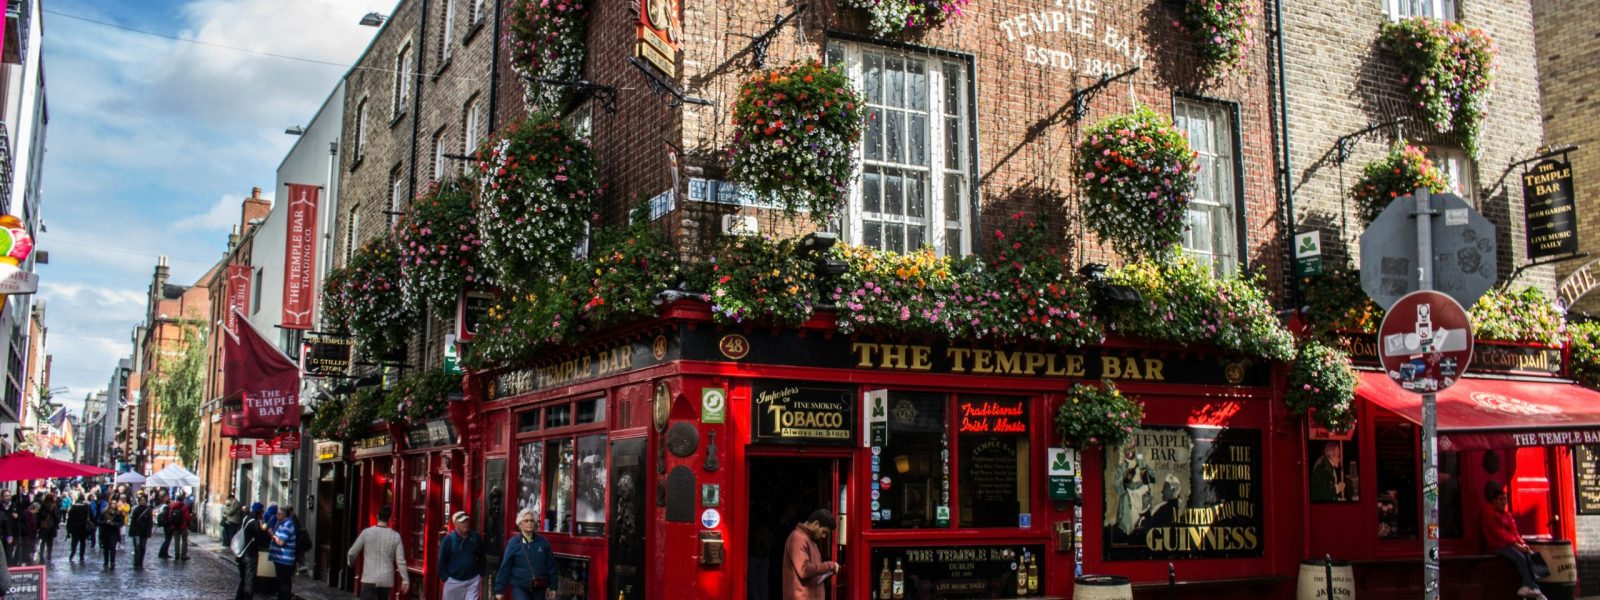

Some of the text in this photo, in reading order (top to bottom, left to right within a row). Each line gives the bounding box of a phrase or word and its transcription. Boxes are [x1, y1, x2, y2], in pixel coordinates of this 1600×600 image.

[999, 11, 1149, 69] TEMPLE BAR
[1024, 44, 1077, 70] ESTD.
[1538, 164, 1554, 172] THE
[1524, 168, 1570, 186] TEMPLE
[1536, 183, 1560, 196] BAR
[1528, 204, 1572, 219] BEER GARDEN
[1531, 230, 1572, 244] LIVE MUSIC
[1540, 240, 1562, 250] DAILY
[290, 210, 304, 304] THE TEMPLE BAR
[302, 241, 310, 289] TRADING
[238, 284, 246, 300] THE
[1561, 266, 1596, 305] THE
[725, 338, 743, 352] 48
[537, 356, 592, 390] TEMPLE
[600, 346, 632, 374] BAR
[852, 342, 1164, 380] THE TEMPLE BAR
[246, 394, 294, 408] TEMPLE
[756, 386, 799, 404] Importers
[260, 406, 284, 416] BAR
[810, 402, 842, 410] SMOKING
[962, 402, 1022, 416] Traditional
[768, 404, 843, 432] TOBACCO
[960, 418, 1026, 432] Irish Music
[784, 428, 812, 437] Always
[1513, 434, 1537, 446] THE
[1538, 432, 1582, 444] TEMPLE
[1136, 434, 1189, 448] TEMPLE
[1151, 448, 1177, 462] BAR
[1230, 446, 1250, 462] THE
[1202, 464, 1250, 480] EMPEROR
[1239, 483, 1250, 498] OF
[1172, 501, 1254, 525] MALTED LIQUORS
[1146, 526, 1258, 550] GUINNESS
[906, 549, 934, 563] THE
[936, 548, 987, 562] TEMPLE
[1316, 587, 1350, 598] JAESON
